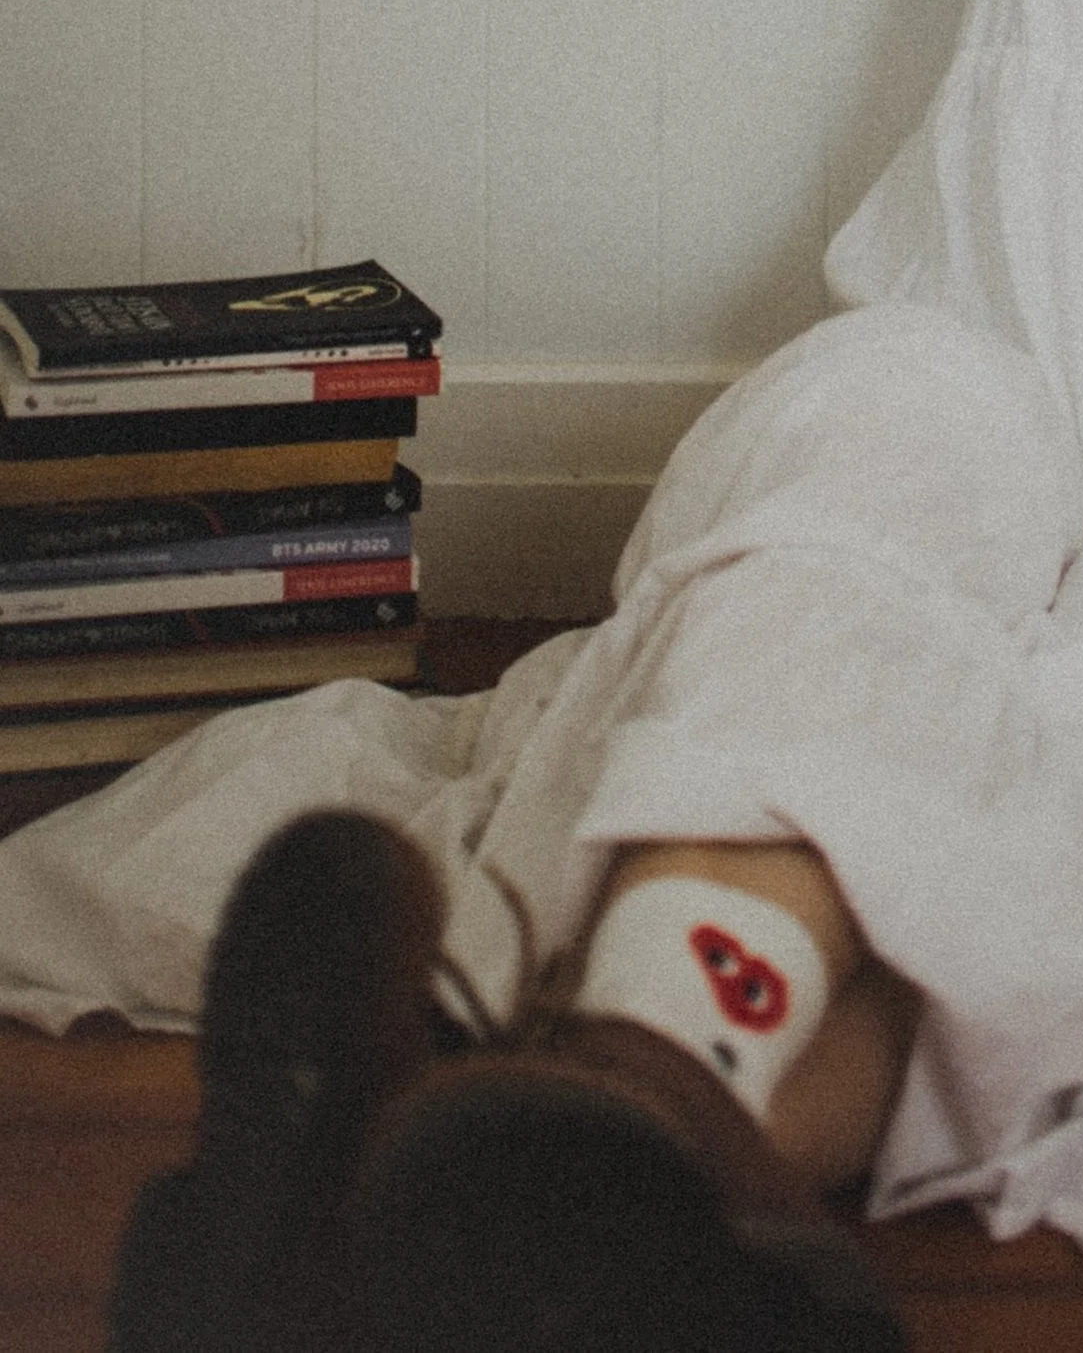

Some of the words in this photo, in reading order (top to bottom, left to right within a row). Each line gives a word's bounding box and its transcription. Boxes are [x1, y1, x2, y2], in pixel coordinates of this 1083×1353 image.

[272, 542, 301, 557] BTS
[304, 539, 348, 555] ARMY
[351, 537, 390, 553] 2020
